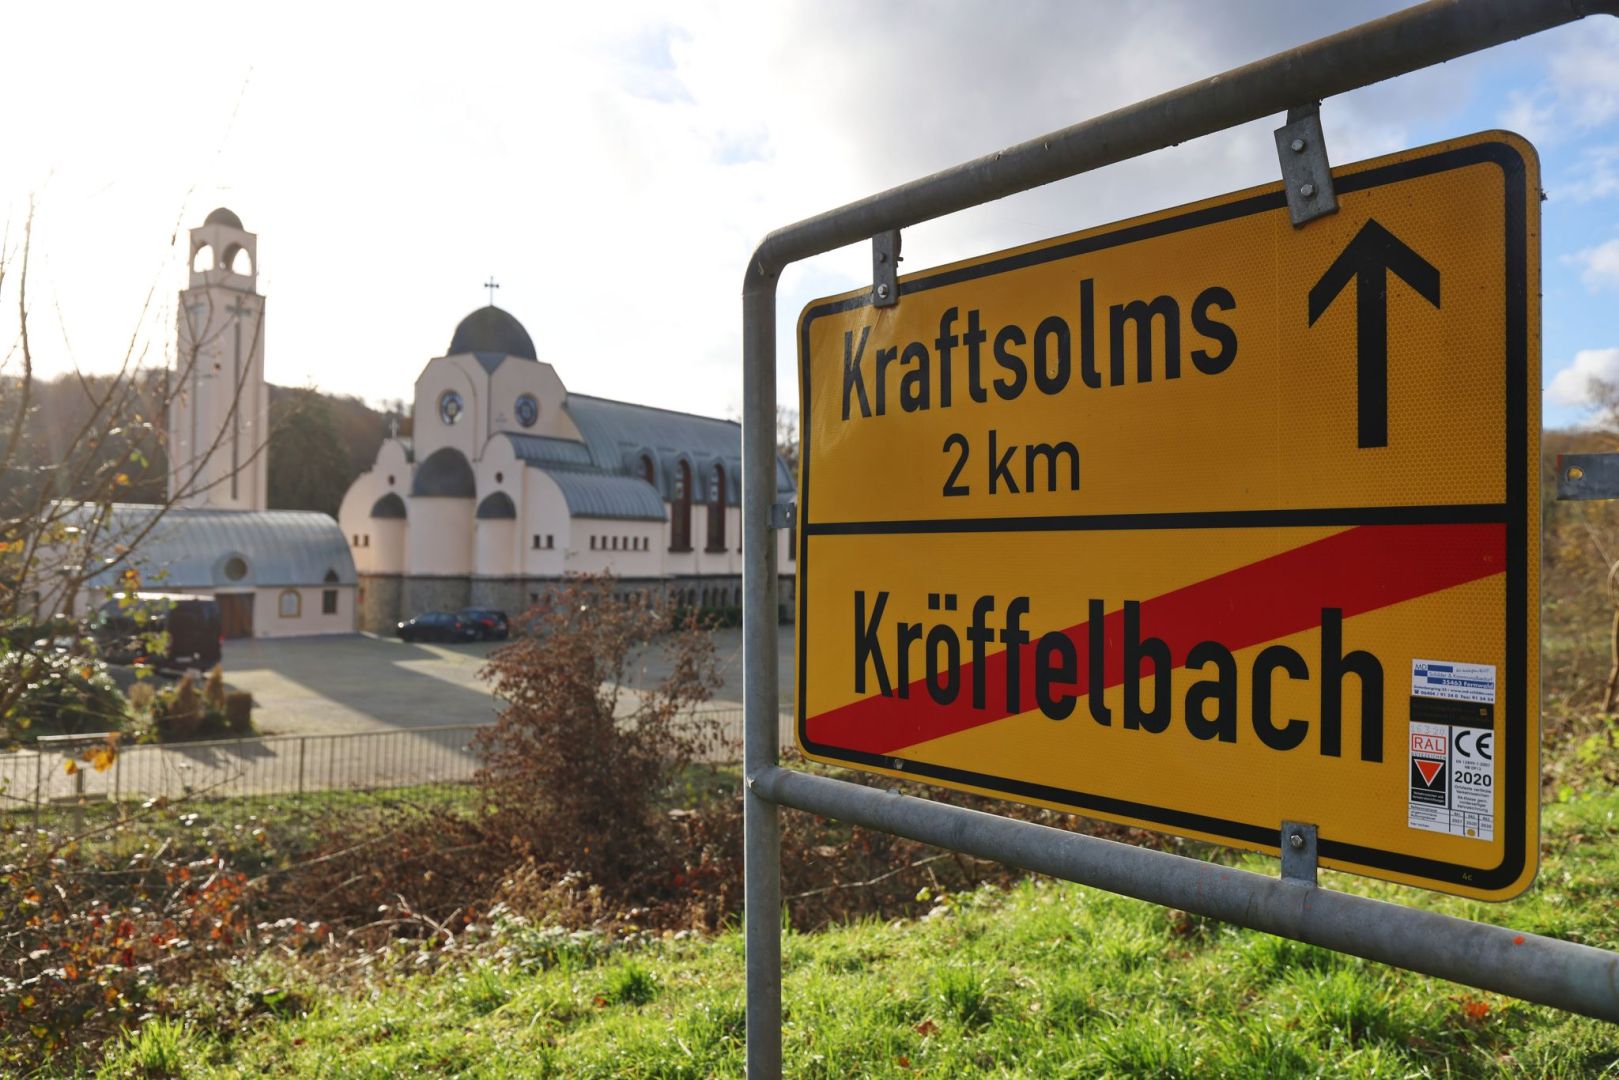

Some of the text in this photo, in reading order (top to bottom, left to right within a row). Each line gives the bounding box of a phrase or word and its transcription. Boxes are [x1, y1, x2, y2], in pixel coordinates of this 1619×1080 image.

[841, 278, 1237, 421] Kraftsolms
[942, 430, 1081, 497] 2 km
[853, 590, 1384, 763] Kröffelbach
[1414, 736, 1443, 752] RAL
[1454, 730, 1492, 760] CE
[1454, 770, 1492, 787] 2020
